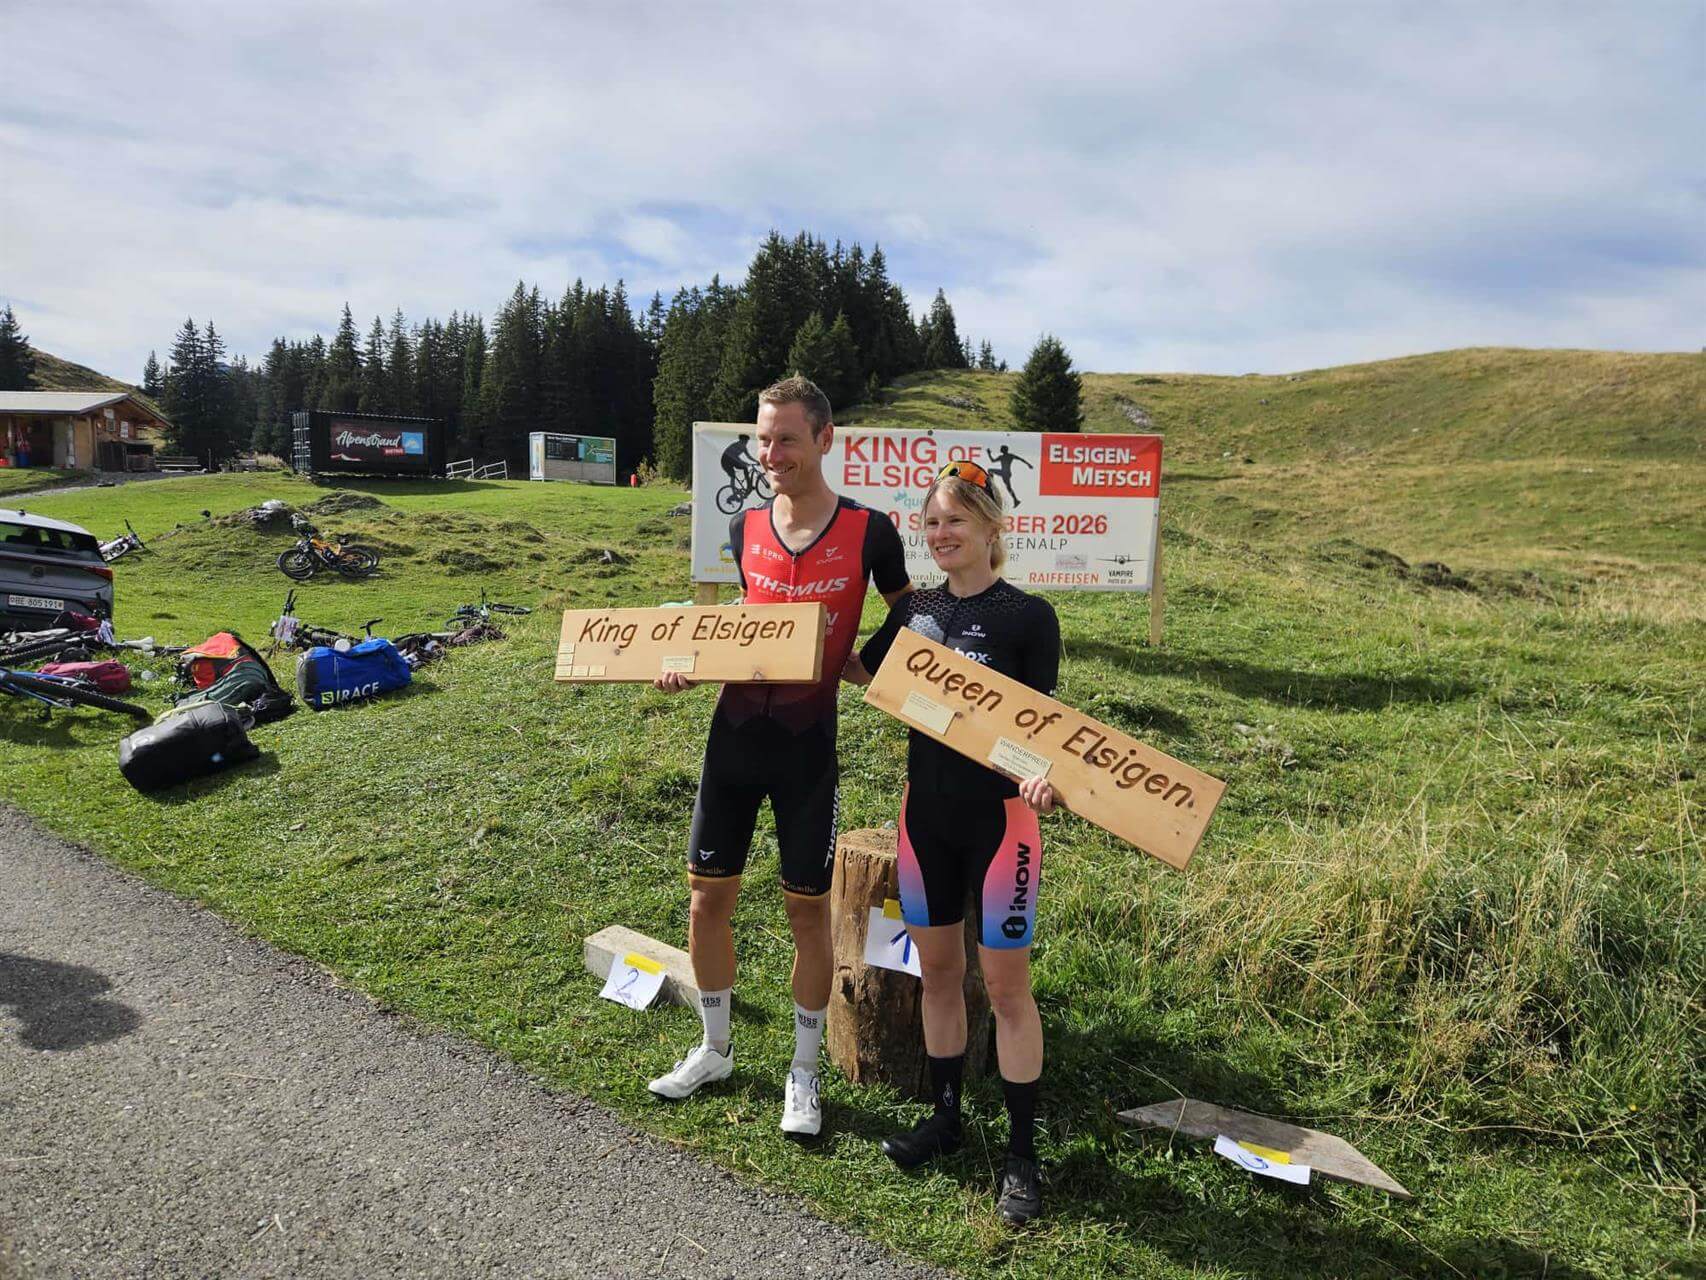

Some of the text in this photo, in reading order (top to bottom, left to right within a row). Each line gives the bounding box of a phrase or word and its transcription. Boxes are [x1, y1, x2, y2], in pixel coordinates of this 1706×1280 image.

[336, 430, 402, 449] Alpenstrand
[844, 436, 982, 465] KING OF
[1049, 444, 1137, 464] ELSIGEN-
[843, 463, 935, 489] ELSIG
[1072, 467, 1152, 487] METSCH
[1052, 514, 1108, 535] 2026
[1029, 572, 1099, 585] RAIFFEISEN
[1108, 569, 1134, 578] VAMPIRE
[579, 616, 638, 649] King
[651, 616, 685, 642] of
[692, 613, 796, 647] Elsigen
[906, 648, 1193, 808] Queen of Elsigen
[613, 967, 639, 1001] 2
